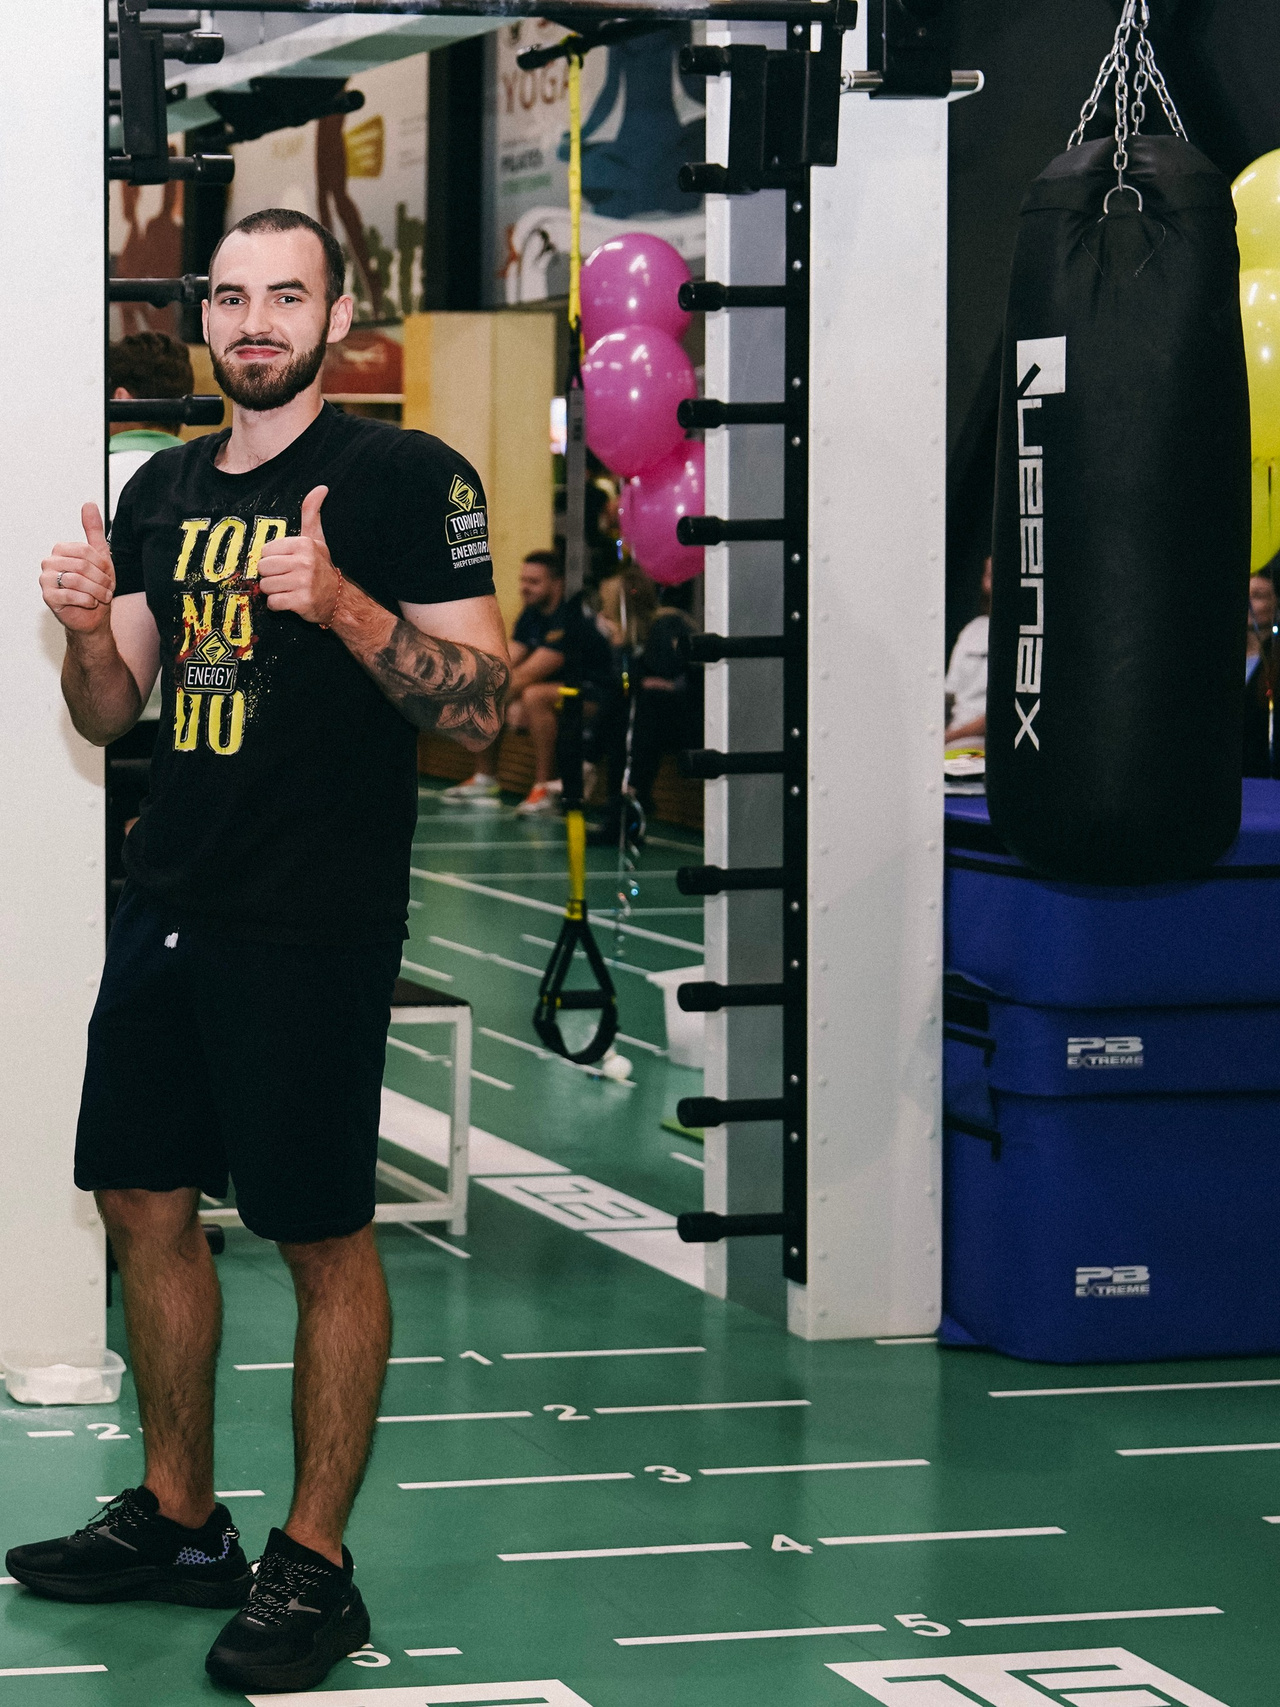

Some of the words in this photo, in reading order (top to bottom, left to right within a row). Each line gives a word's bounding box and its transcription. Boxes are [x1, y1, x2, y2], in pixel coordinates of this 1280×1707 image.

[187, 666, 235, 686] ENERGY
[459, 1350, 493, 1365] 1
[542, 1404, 591, 1421] 2
[86, 1423, 131, 1440] 2
[643, 1465, 692, 1483] 3
[771, 1534, 814, 1554] 4
[893, 1613, 952, 1637] 5
